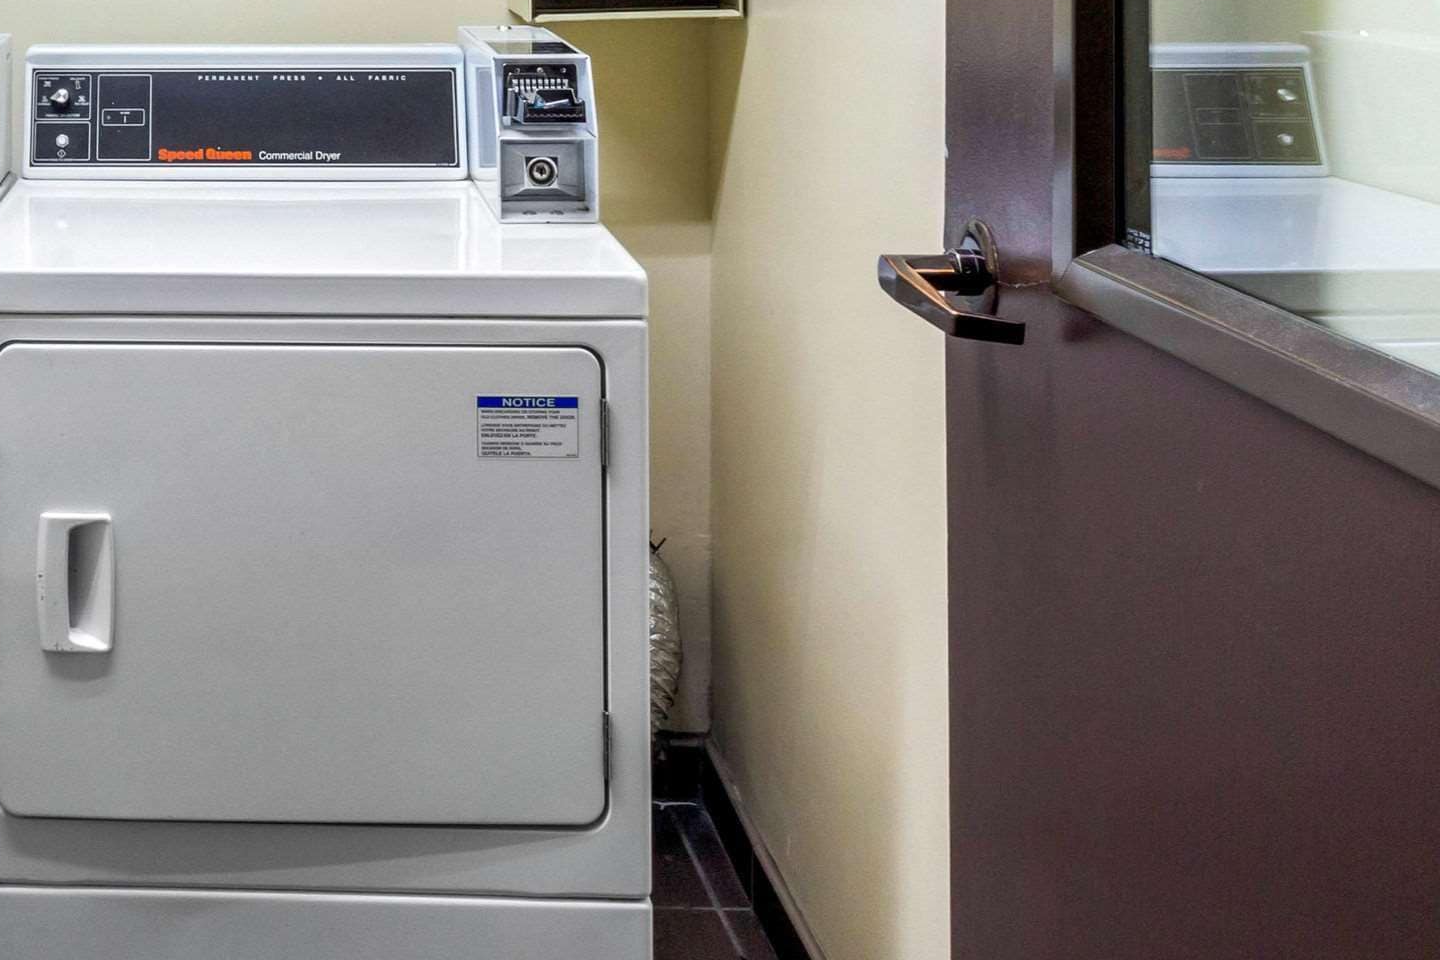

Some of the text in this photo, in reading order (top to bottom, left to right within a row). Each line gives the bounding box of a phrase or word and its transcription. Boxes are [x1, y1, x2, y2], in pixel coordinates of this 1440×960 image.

[158, 147, 342, 162] Speed Queen Commercial Dryer
[502, 398, 556, 407] NOTICE
